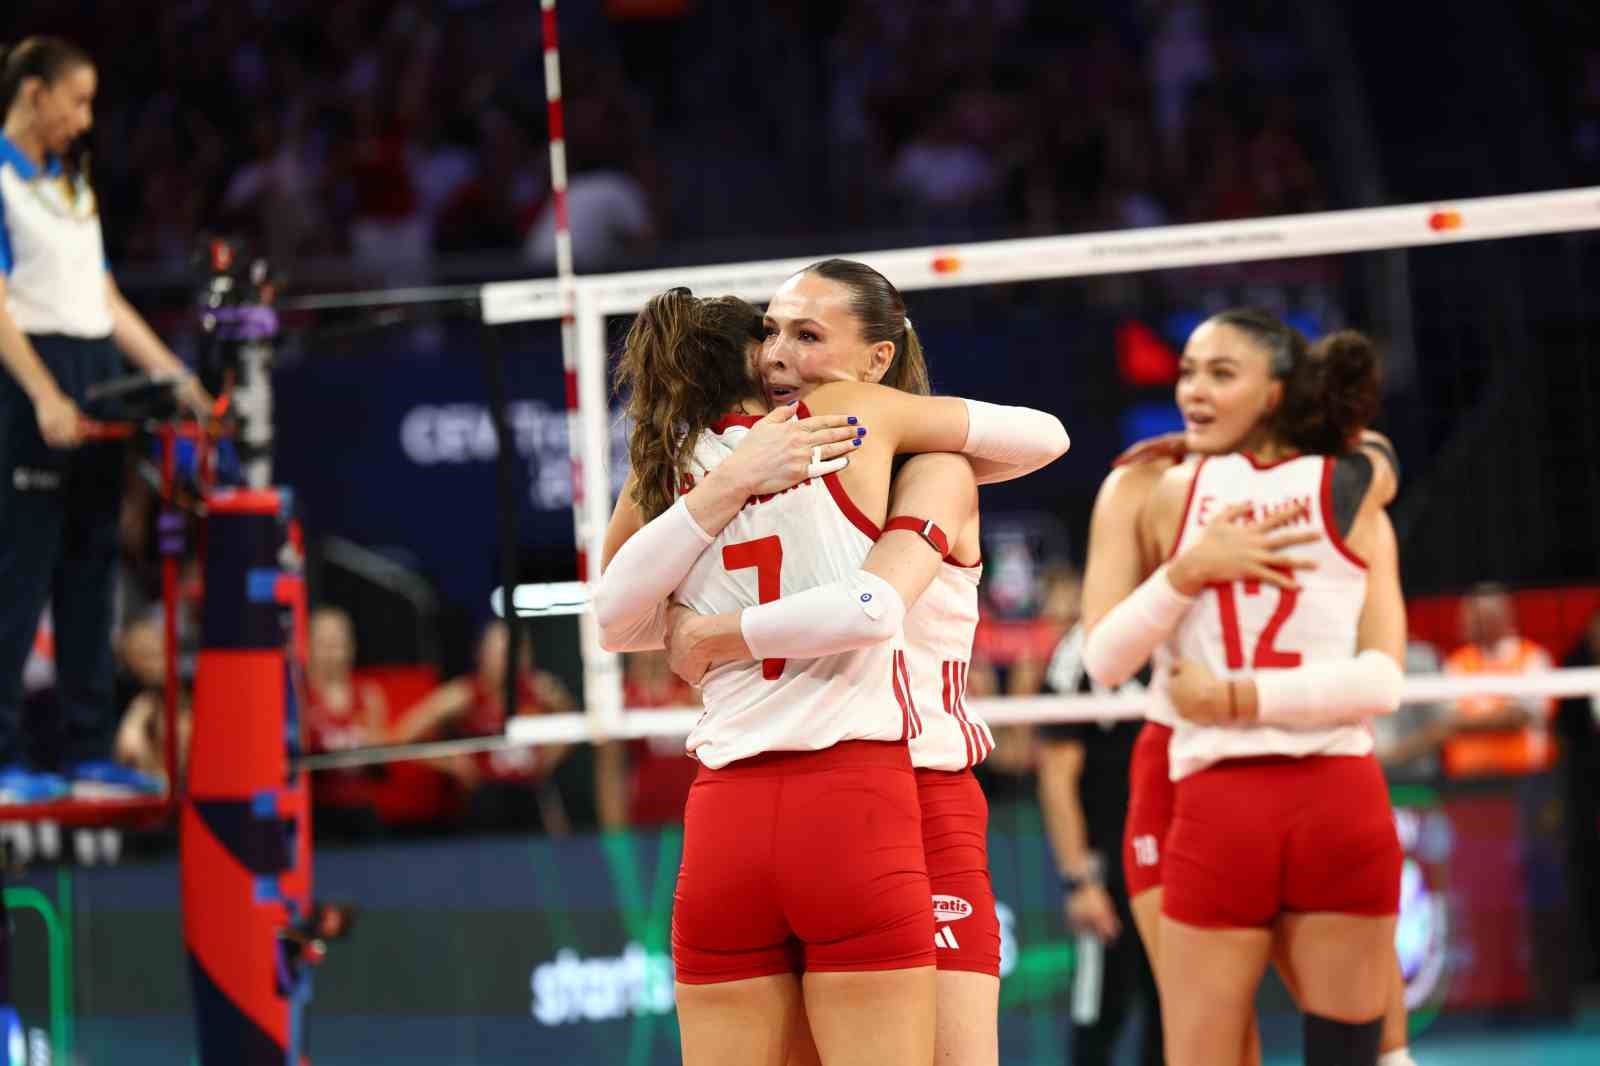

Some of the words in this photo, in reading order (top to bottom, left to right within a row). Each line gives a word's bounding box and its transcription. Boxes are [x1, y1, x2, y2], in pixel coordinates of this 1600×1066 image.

[722, 534, 785, 681] 7
[1204, 564, 1303, 669] 12
[933, 899, 968, 912] ratis
